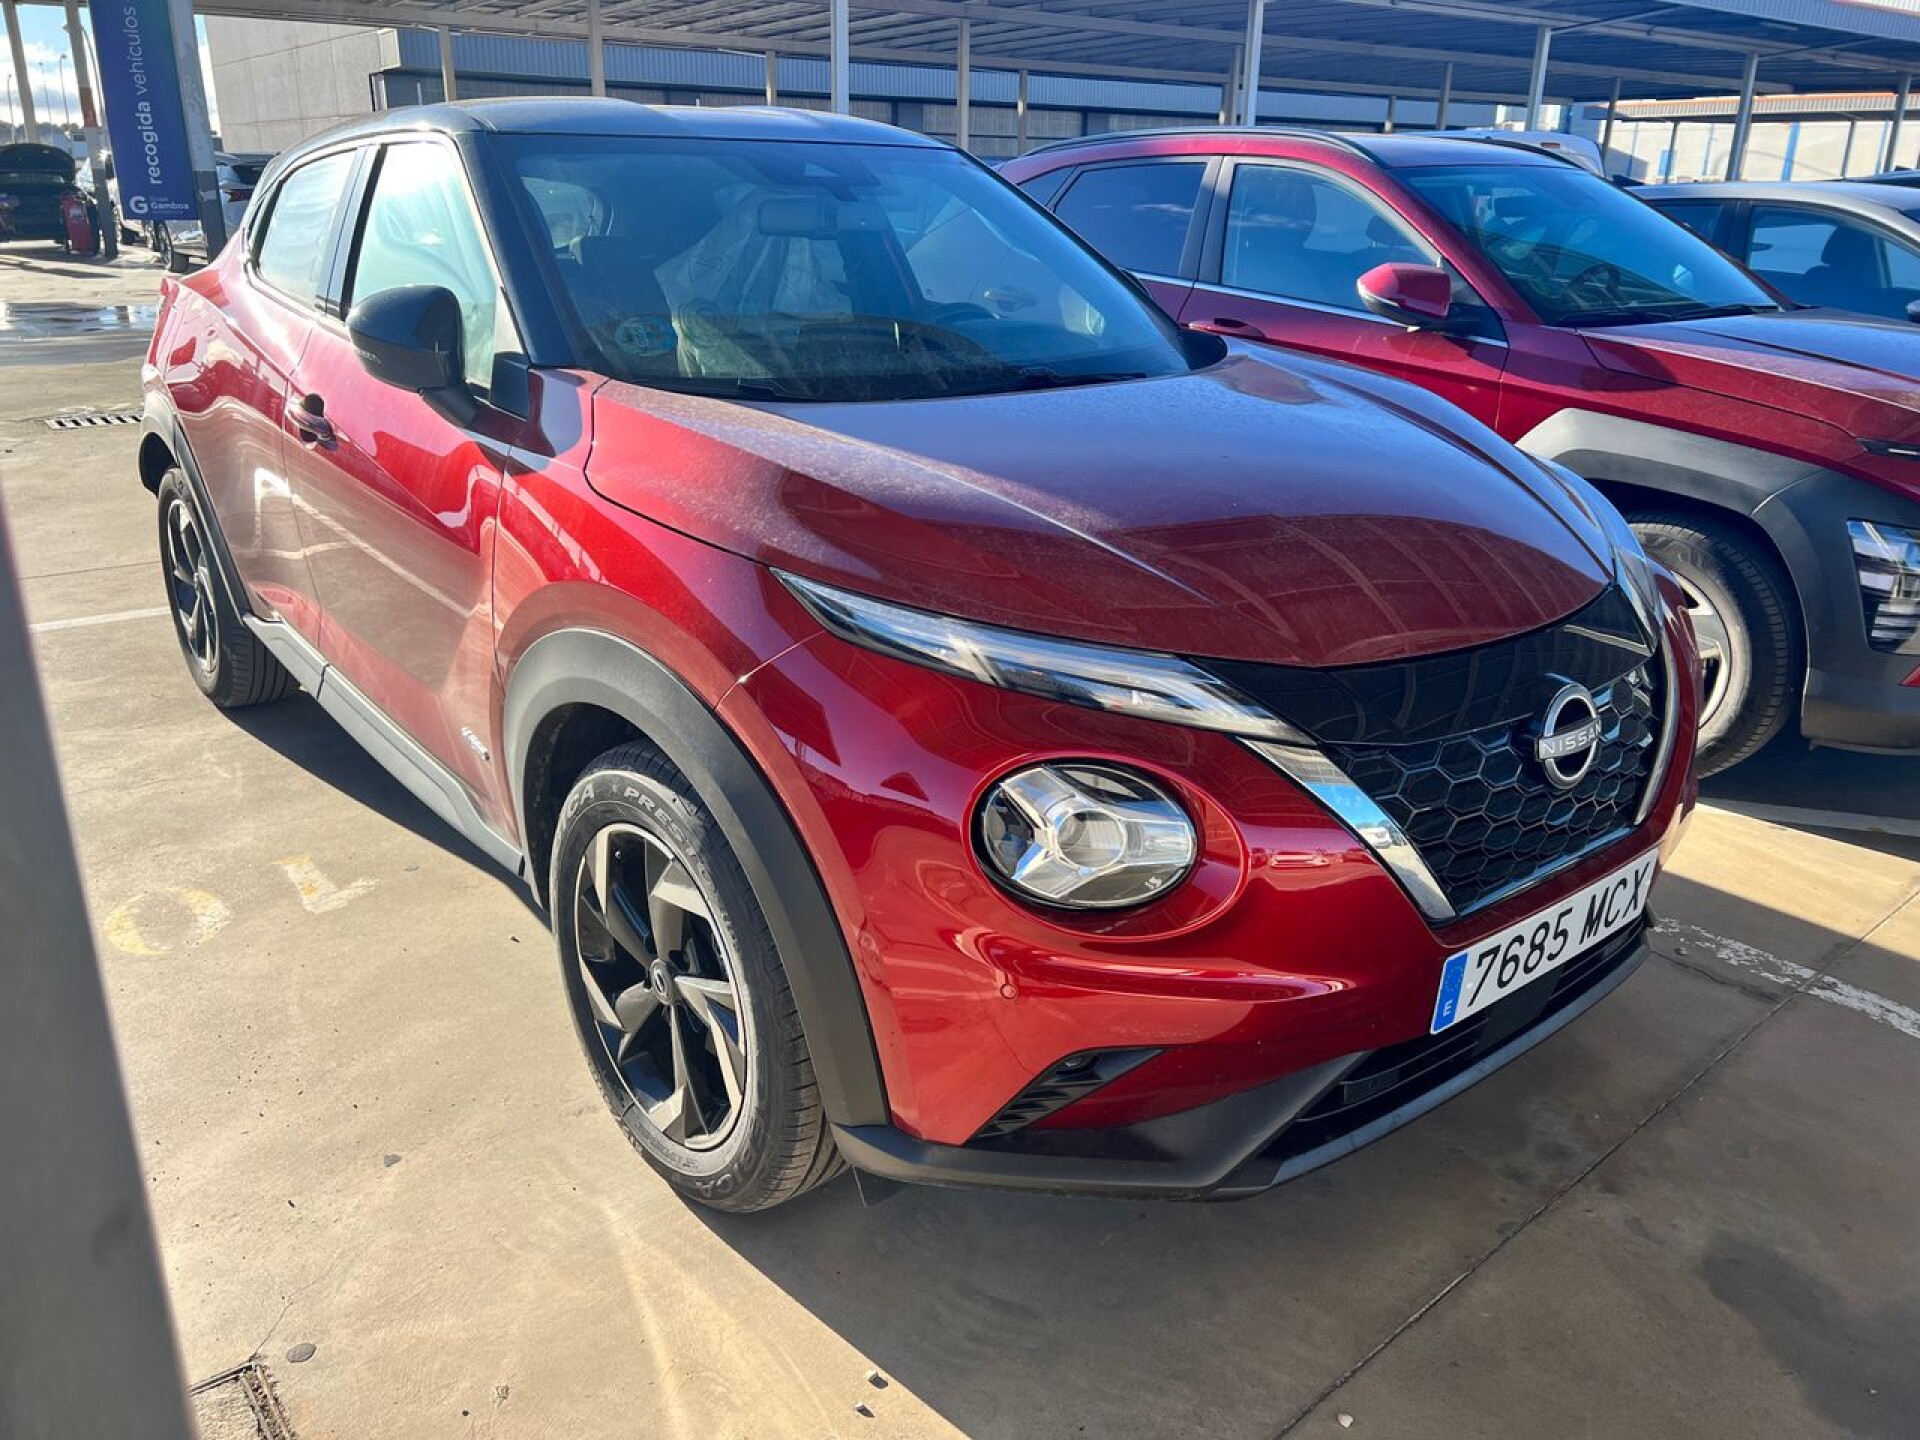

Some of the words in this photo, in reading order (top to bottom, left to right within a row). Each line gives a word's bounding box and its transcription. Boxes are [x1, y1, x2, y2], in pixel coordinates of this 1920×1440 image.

[135, 101, 163, 185] recogida
[129, 195, 148, 214] G
[1543, 722, 1601, 755] NISSAN
[1468, 908, 1574, 1009] 7685
[1579, 861, 1650, 945] MCX
[1442, 999, 1452, 1017] E
